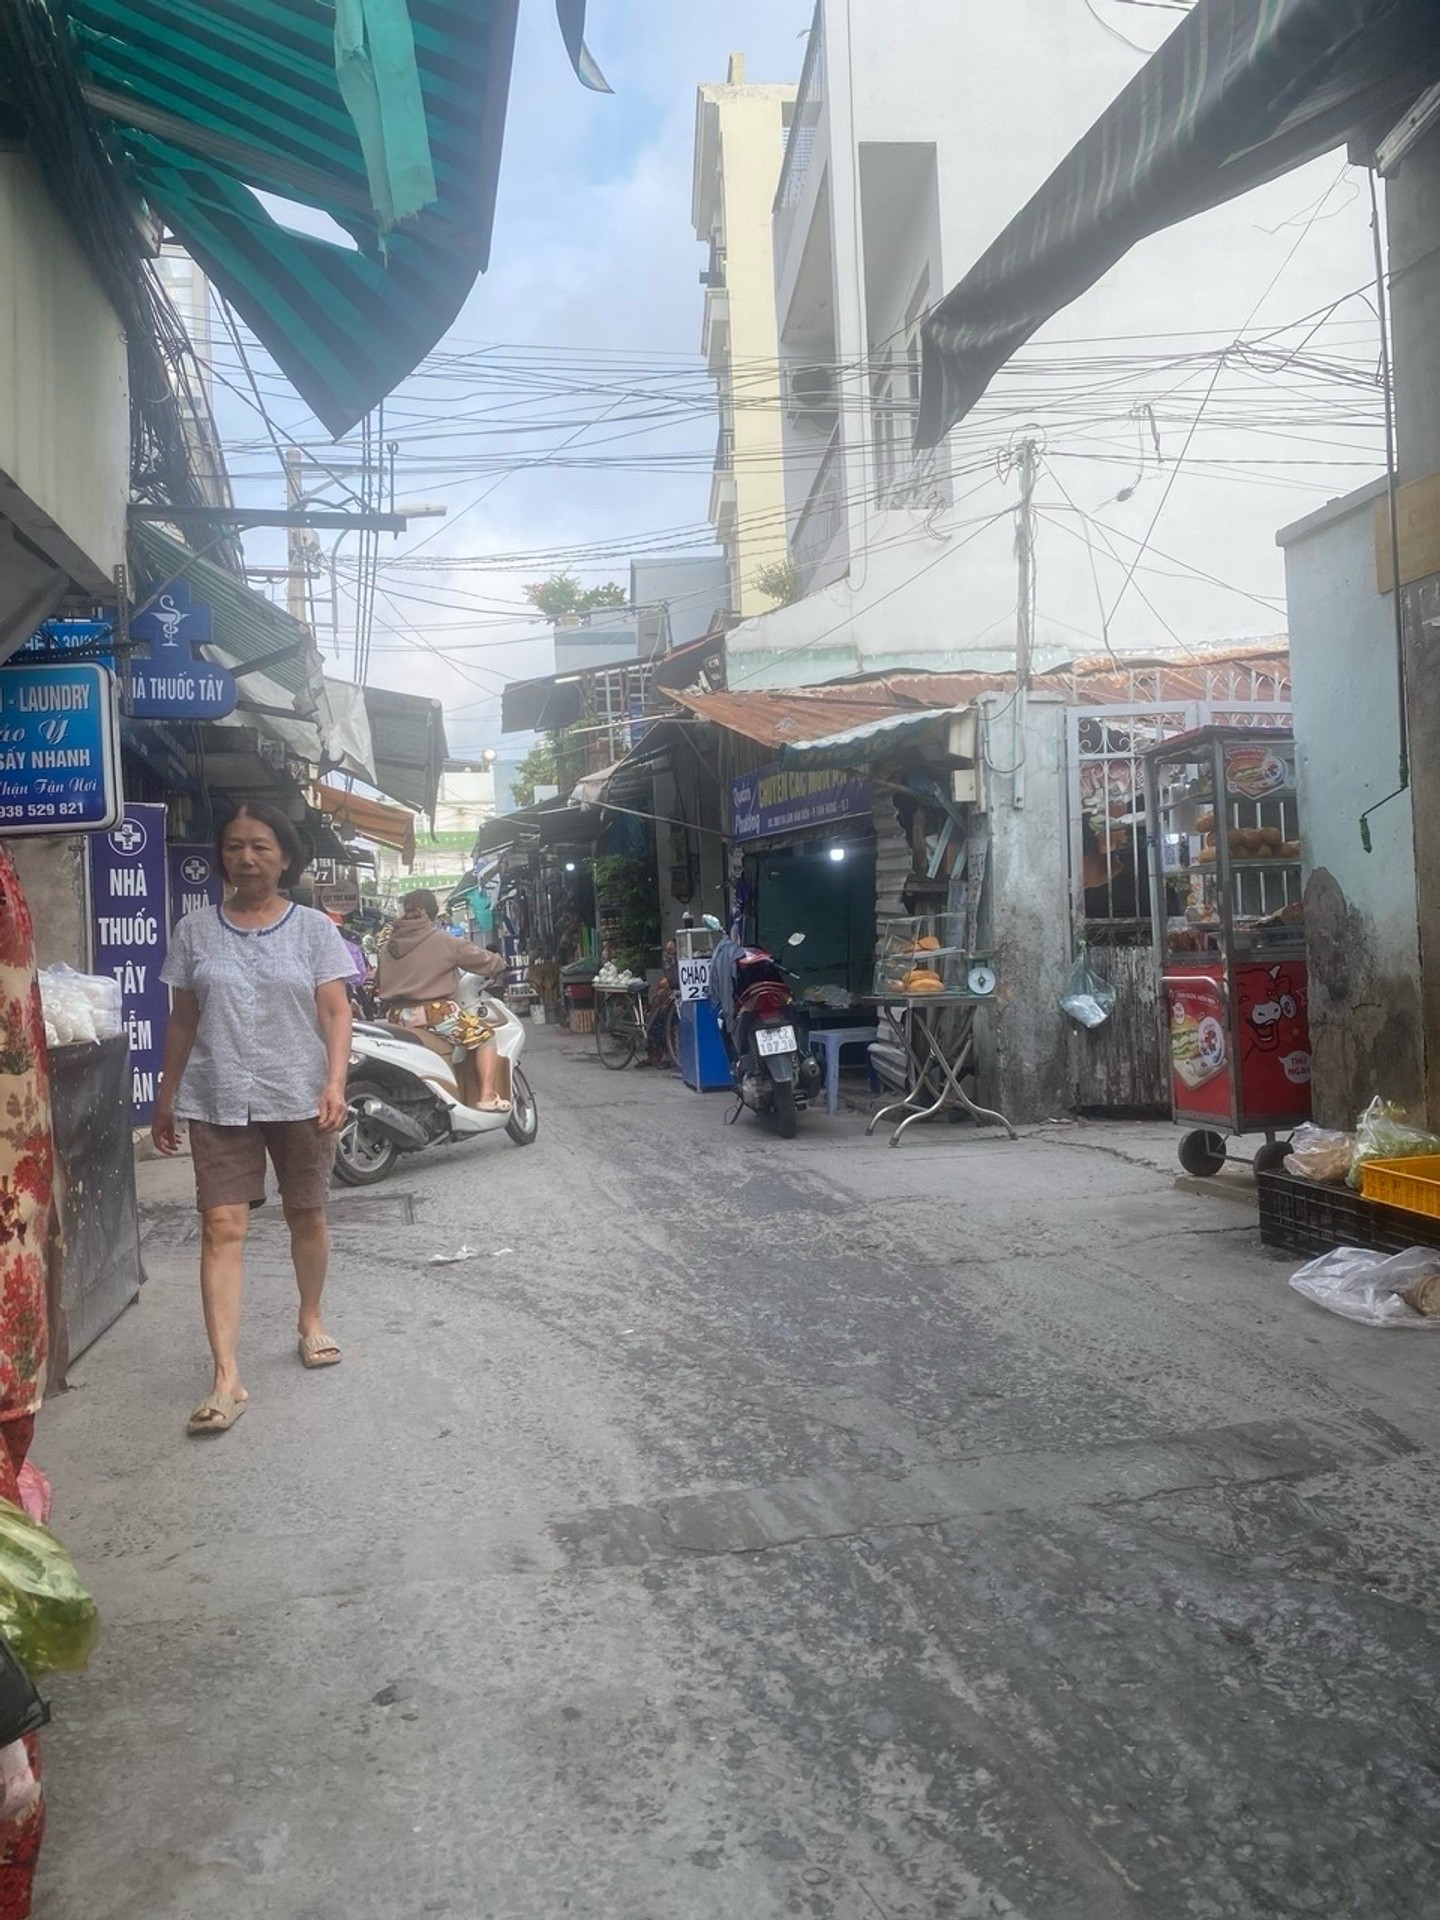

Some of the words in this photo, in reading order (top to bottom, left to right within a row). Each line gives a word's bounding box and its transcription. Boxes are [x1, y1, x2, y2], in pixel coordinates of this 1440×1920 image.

[20, 684, 90, 712] LAUNDRY
[150, 671, 195, 700] THUỐC
[199, 673, 224, 701] TÂY
[31, 748, 91, 769] NHANH
[34, 778, 64, 796] Tận
[68, 776, 97, 792] Nơi
[28, 803, 55, 817] 529
[59, 801, 84, 815] 821
[109, 863, 148, 897] NHÀ
[98, 907, 158, 946] THUỐC
[113, 960, 147, 994] TÂY
